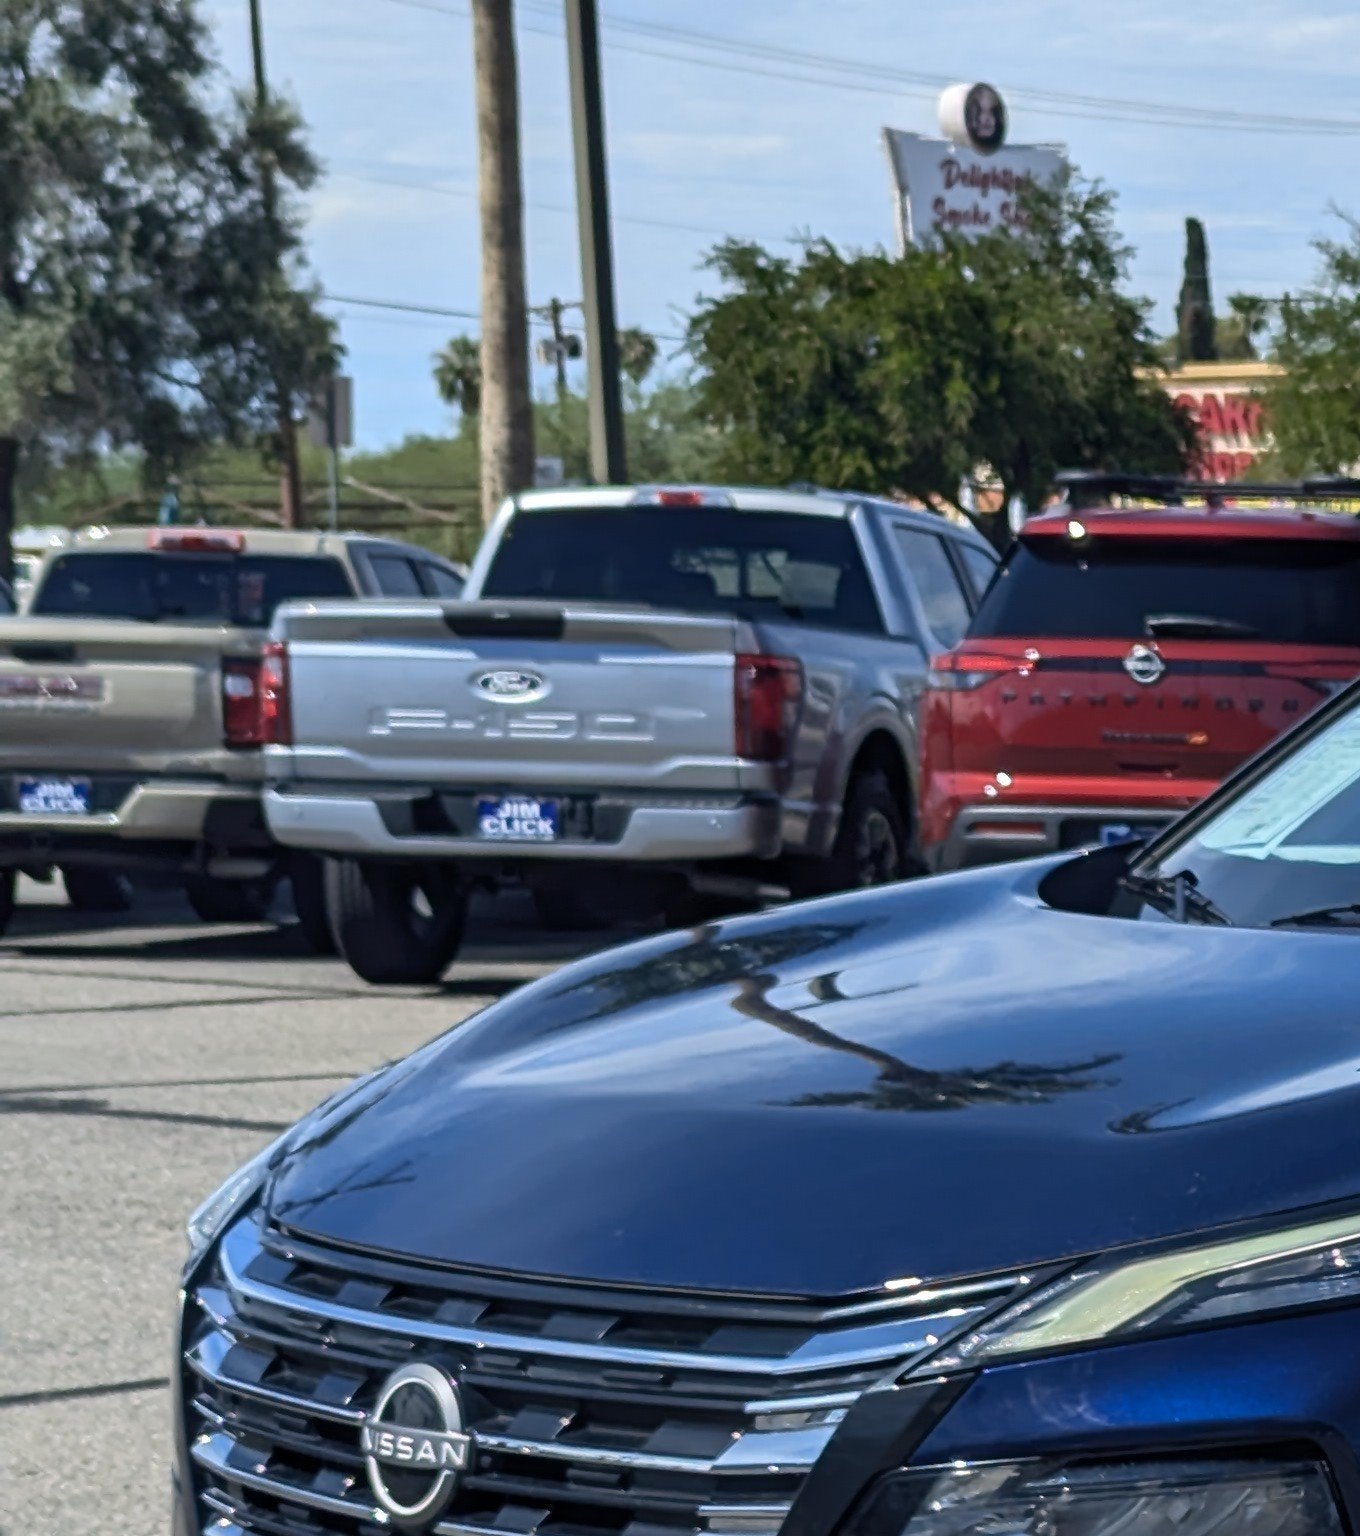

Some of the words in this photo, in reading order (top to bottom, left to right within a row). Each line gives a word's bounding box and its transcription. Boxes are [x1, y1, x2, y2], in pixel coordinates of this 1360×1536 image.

[496, 800, 541, 819] JIM
[481, 816, 555, 835] CLICK
[363, 1424, 467, 1468] NISSAN
